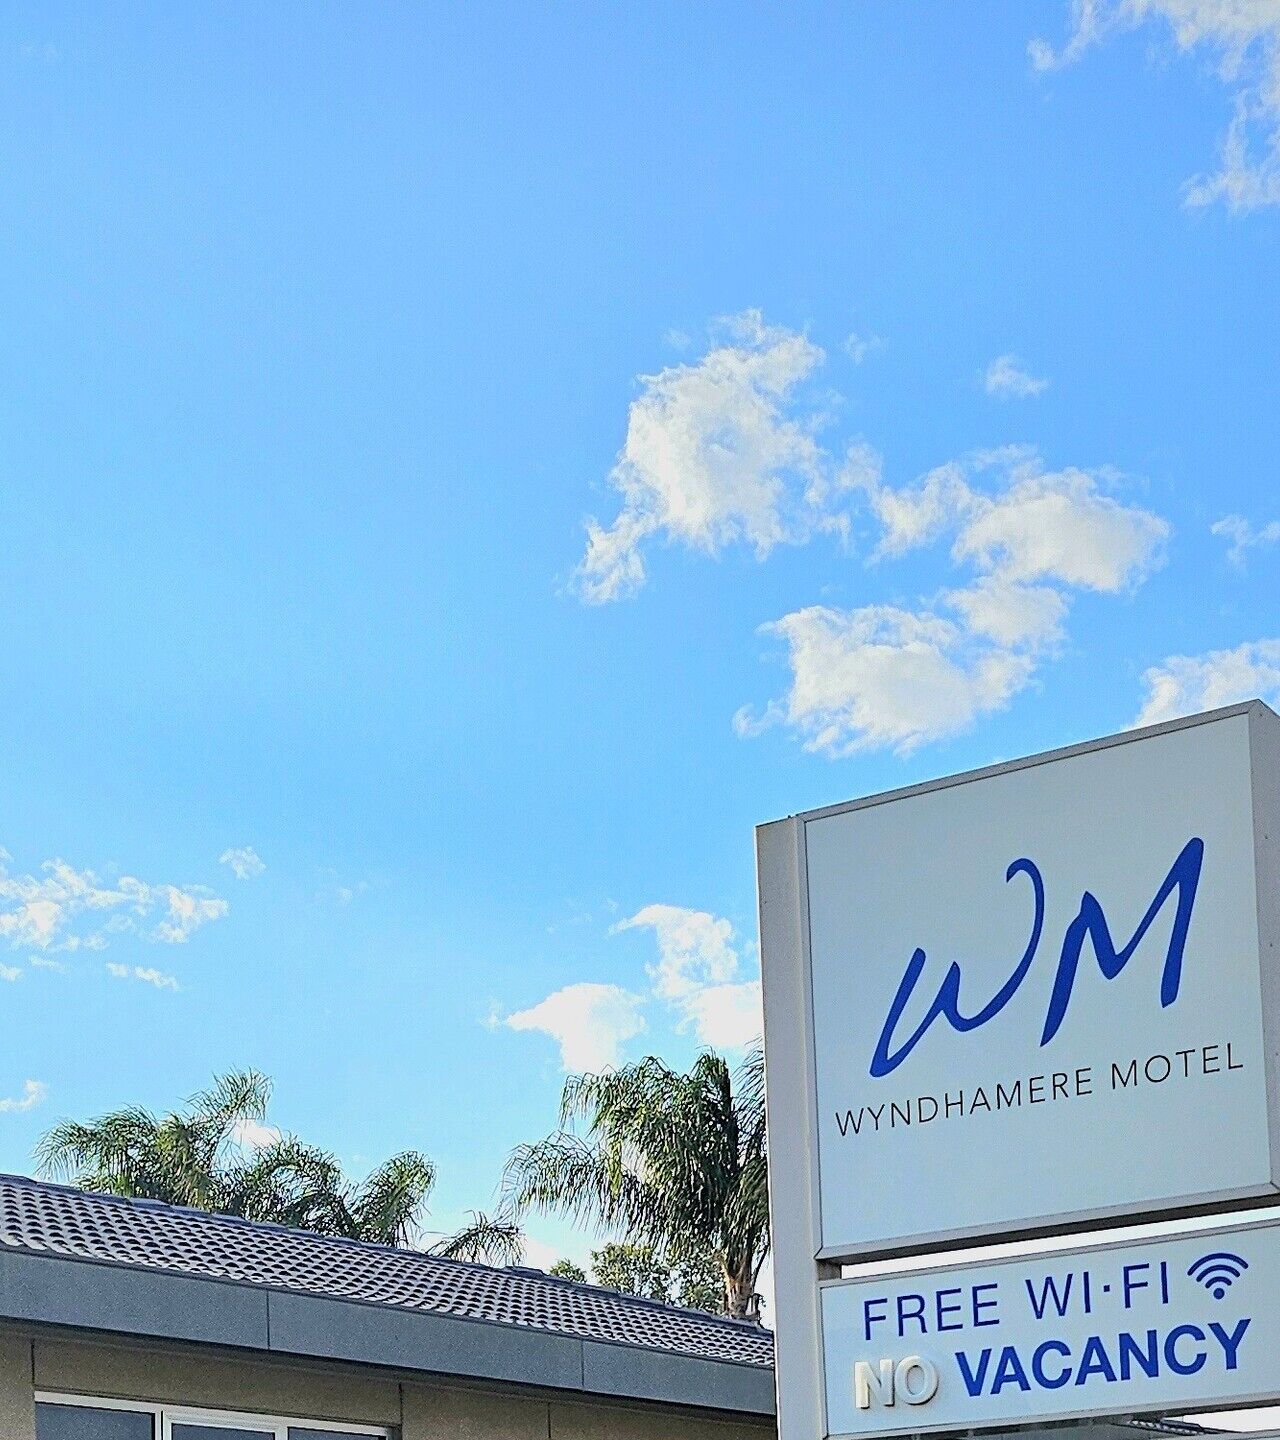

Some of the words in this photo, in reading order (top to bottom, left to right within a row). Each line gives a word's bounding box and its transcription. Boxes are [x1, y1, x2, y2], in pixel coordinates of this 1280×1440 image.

[869, 836, 1205, 1078] WM
[835, 1066, 1093, 1137] WYNDHAMERE
[1111, 1042, 1244, 1090] MOTEL
[863, 1283, 1000, 1341] FREE
[855, 1355, 940, 1409] NO
[954, 1318, 1251, 1398] VACANCY
